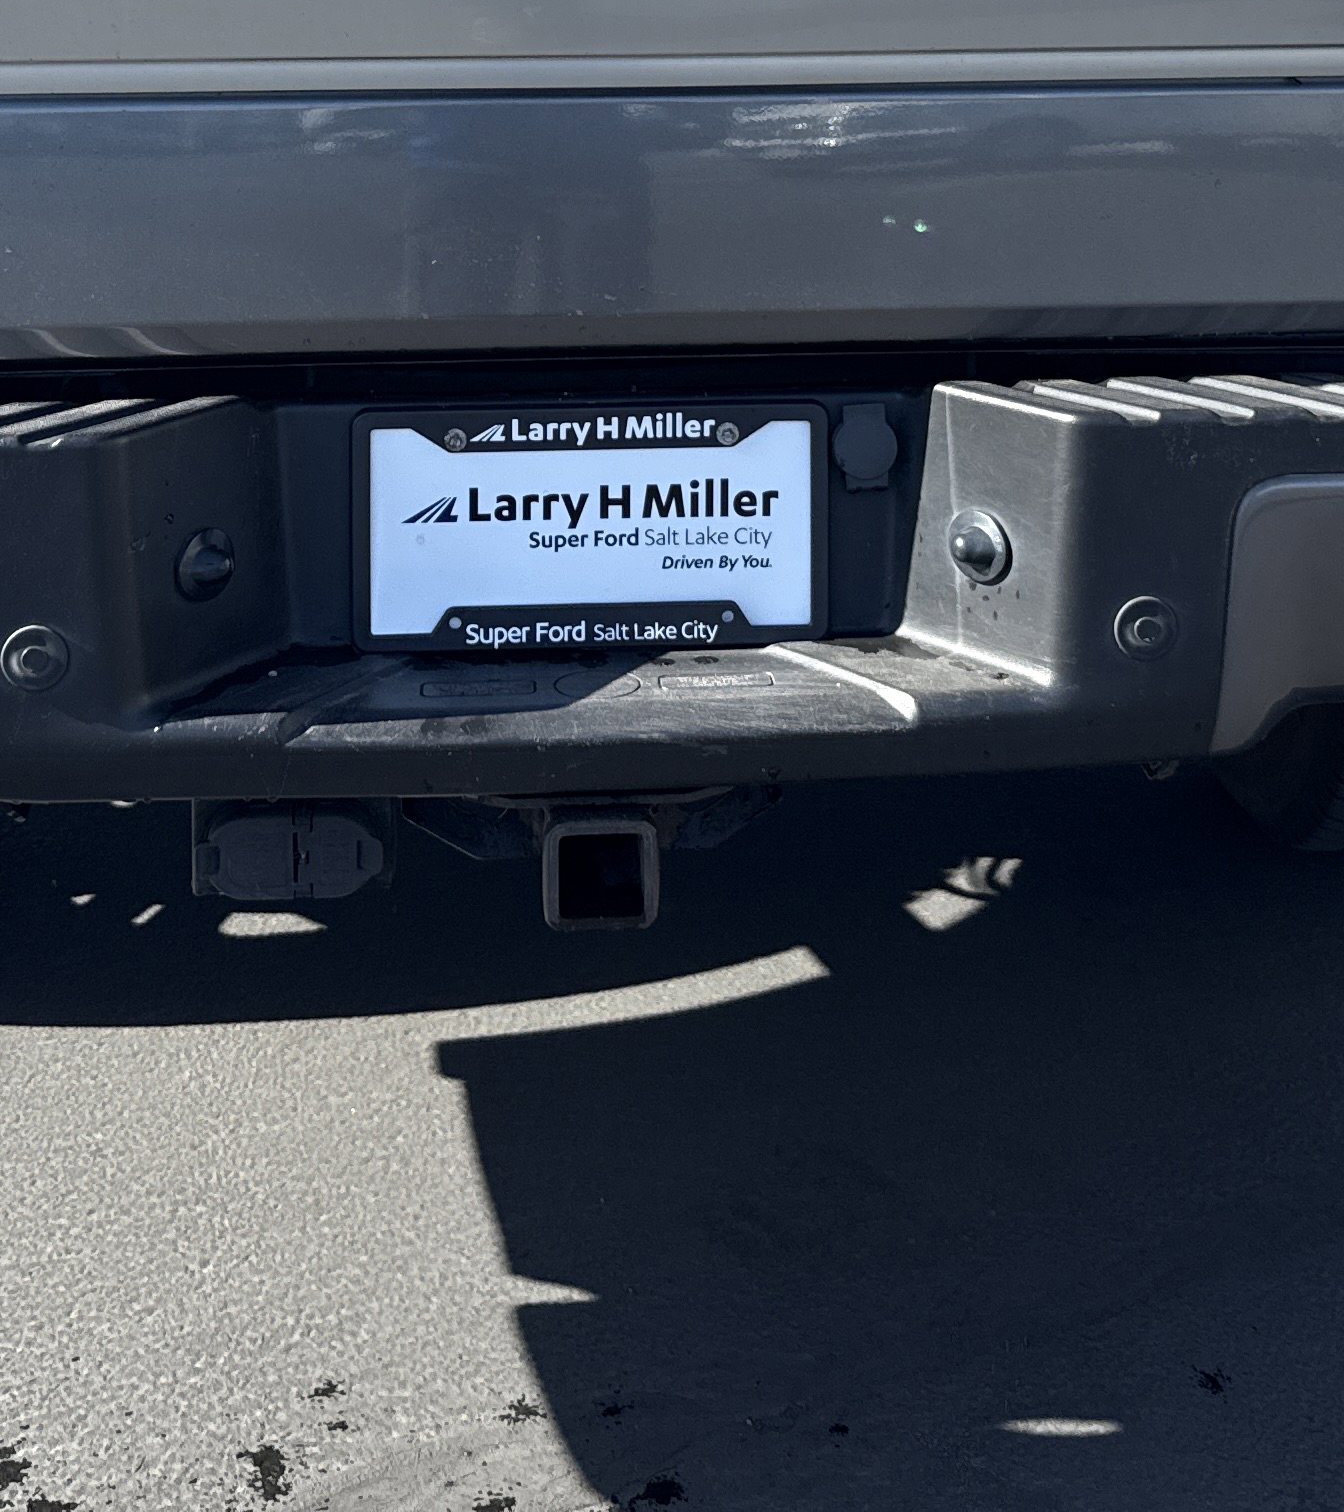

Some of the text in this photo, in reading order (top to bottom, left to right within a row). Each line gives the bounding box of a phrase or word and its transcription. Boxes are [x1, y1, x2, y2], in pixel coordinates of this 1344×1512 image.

[511, 411, 716, 446] Larry H Miller
[468, 477, 779, 529] Larry H Miller
[528, 527, 773, 552] Super Ford Salt Lake City
[662, 555, 714, 570] Driven
[718, 554, 739, 572] By
[465, 619, 718, 649] Super Ford Salt Lake City
